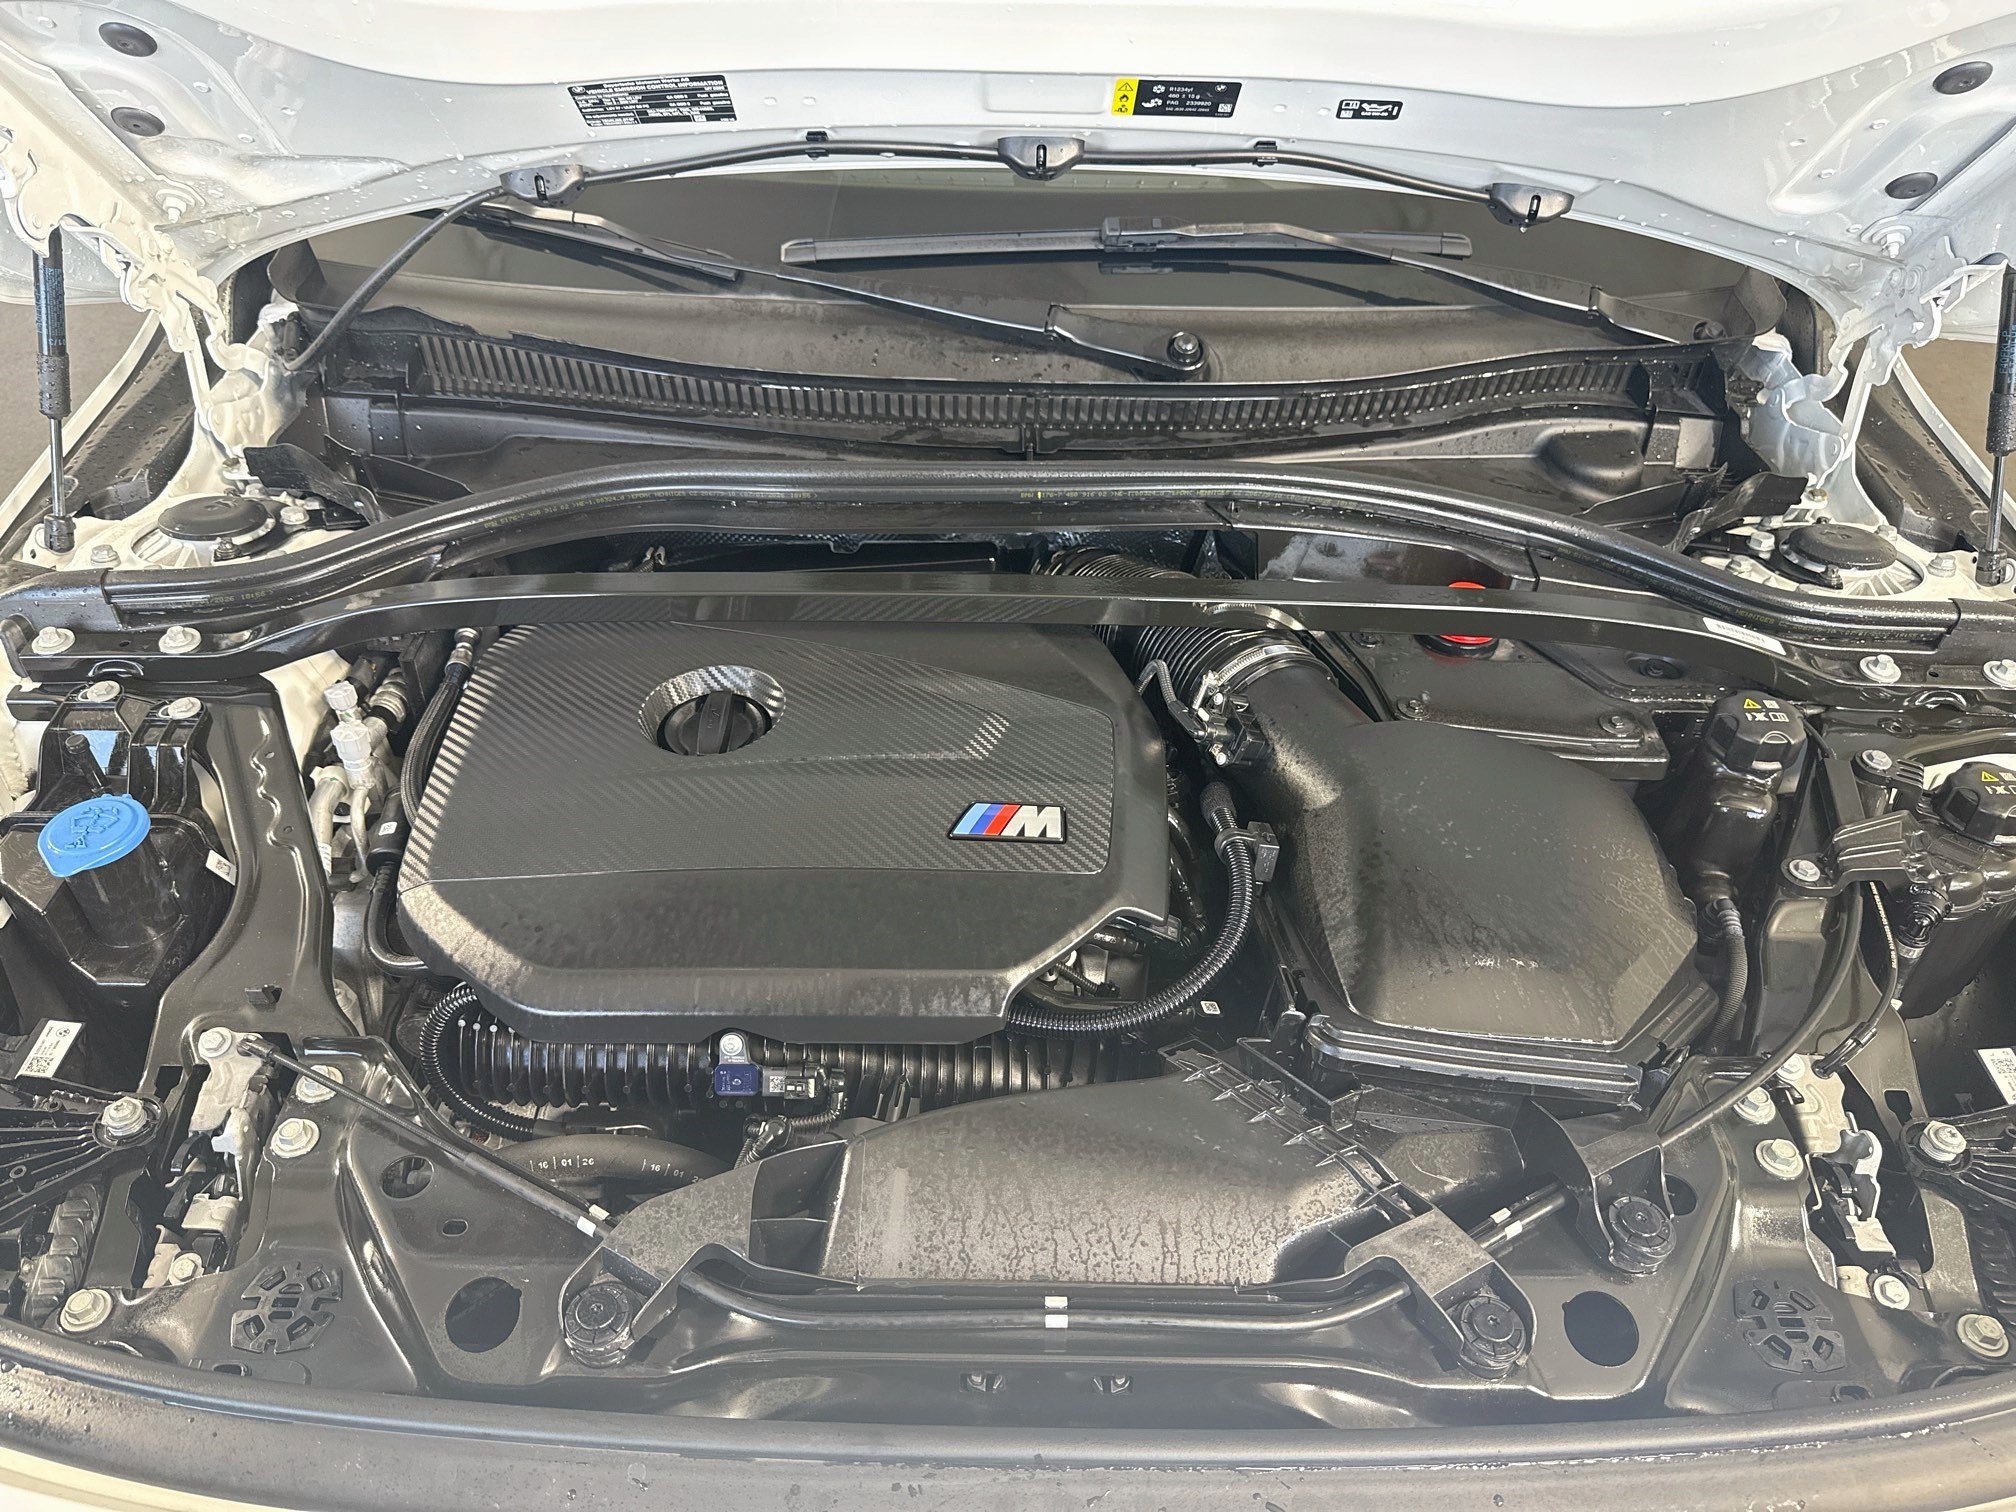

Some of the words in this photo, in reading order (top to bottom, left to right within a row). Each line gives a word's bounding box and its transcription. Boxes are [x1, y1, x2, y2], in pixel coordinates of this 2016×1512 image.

[646, 83, 678, 91] CONTROL
[678, 80, 724, 88] INFORMATION
[1000, 806, 1062, 838] M
[537, 1160, 549, 1170] 16
[560, 1158, 573, 1167] 01
[582, 1157, 595, 1166] 26
[650, 1163, 661, 1172] 16
[673, 1168, 684, 1178] 01
